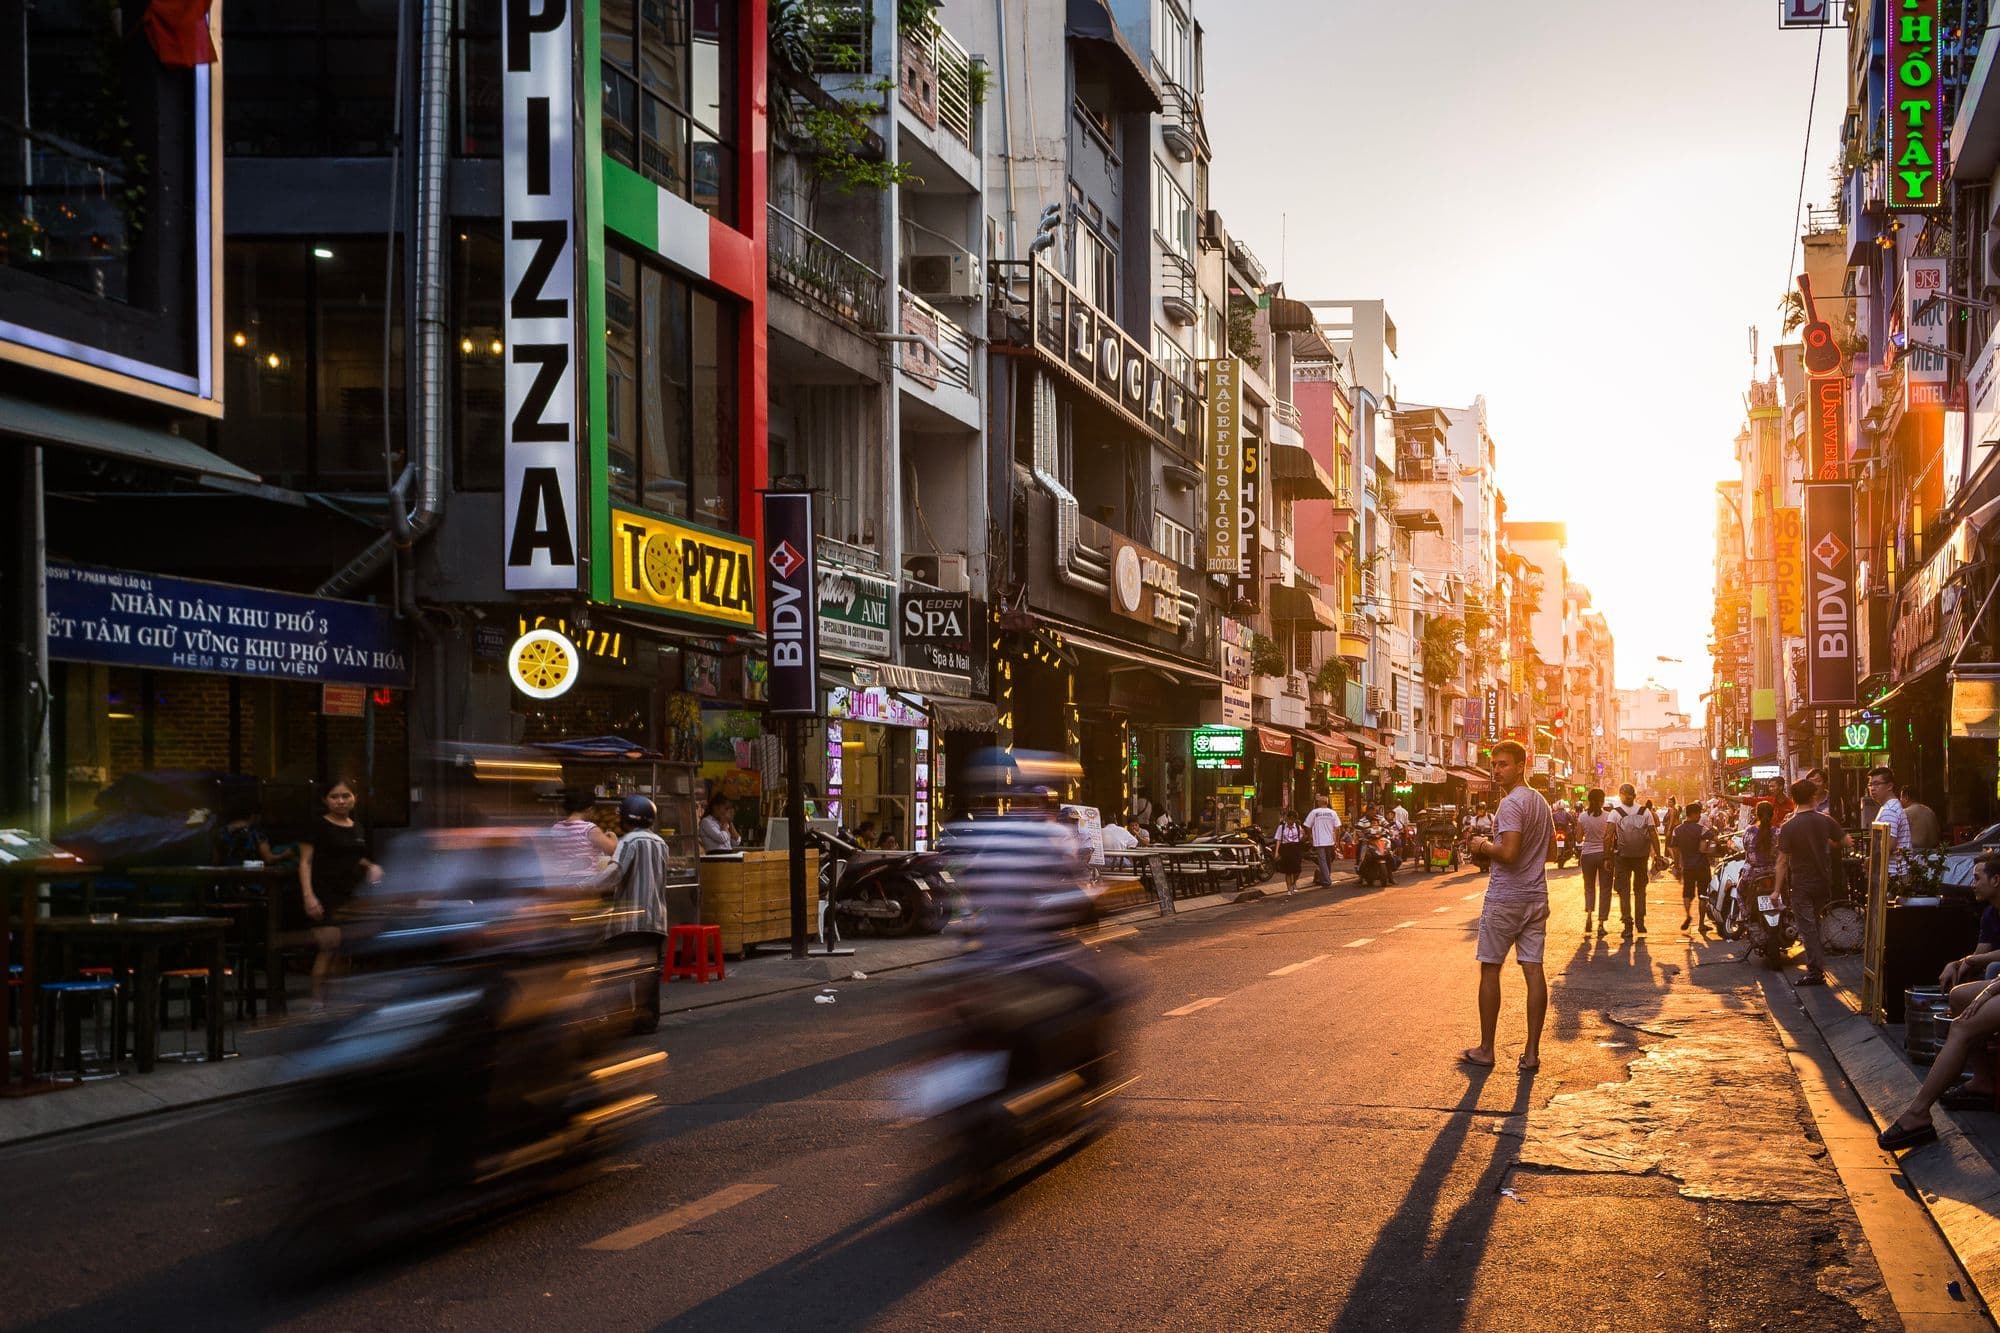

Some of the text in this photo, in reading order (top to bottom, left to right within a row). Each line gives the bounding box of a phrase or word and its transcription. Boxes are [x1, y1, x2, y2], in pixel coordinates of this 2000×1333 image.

[1897, 0, 1933, 198] HỐ TÂY
[507, 0, 575, 566] PIZZA
[1074, 312, 1187, 435] LOCAL
[1912, 387, 1946, 403] HOTEL
[1215, 360, 1232, 470] GRACEFUL
[1215, 475, 1232, 557] SAIGON
[1208, 558, 1238, 571] HOTEL
[110, 592, 328, 635] NHÂN DÂN KHU PHỐ 3
[773, 580, 803, 667] BIDV
[861, 599, 887, 625] ANH
[905, 600, 963, 636] SPA
[925, 600, 963, 609] EDEN
[1817, 571, 1849, 659] BIDV
[82, 617, 131, 644] TÂM
[137, 624, 178, 649] GIỮ
[184, 630, 239, 654] VỮNG
[245, 638, 285, 660] KHU
[290, 639, 328, 664] PHỐ
[332, 646, 369, 668] VĂN
[373, 650, 406, 672] HÓA
[220, 657, 239, 670] 57
[280, 661, 319, 677] VIỆN
[932, 648, 970, 671] Spa & Nail
